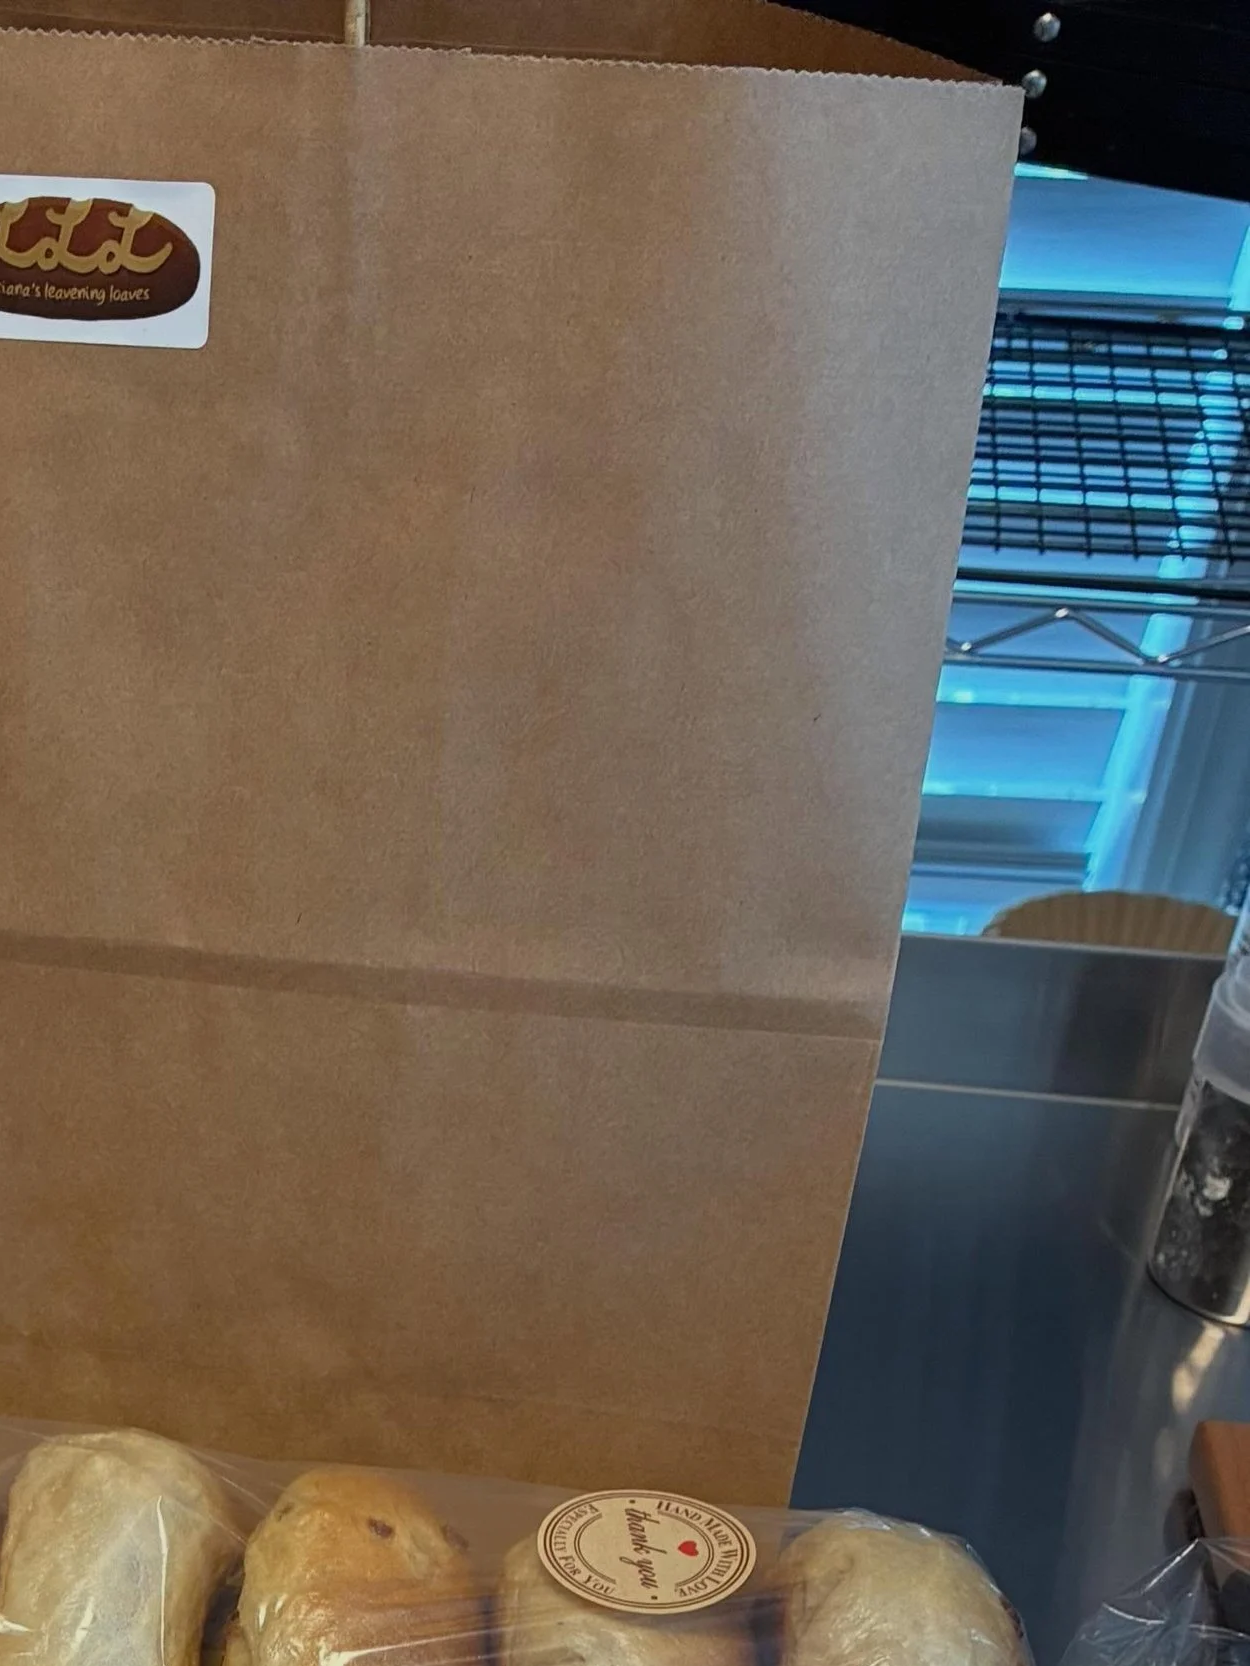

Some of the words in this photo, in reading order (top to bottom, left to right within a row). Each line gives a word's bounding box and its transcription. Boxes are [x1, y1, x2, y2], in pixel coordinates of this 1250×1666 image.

[44, 280, 106, 306] leavening
[109, 284, 150, 302] loaves
[625, 1508, 668, 1556] thank
[619, 1553, 659, 1590] you
